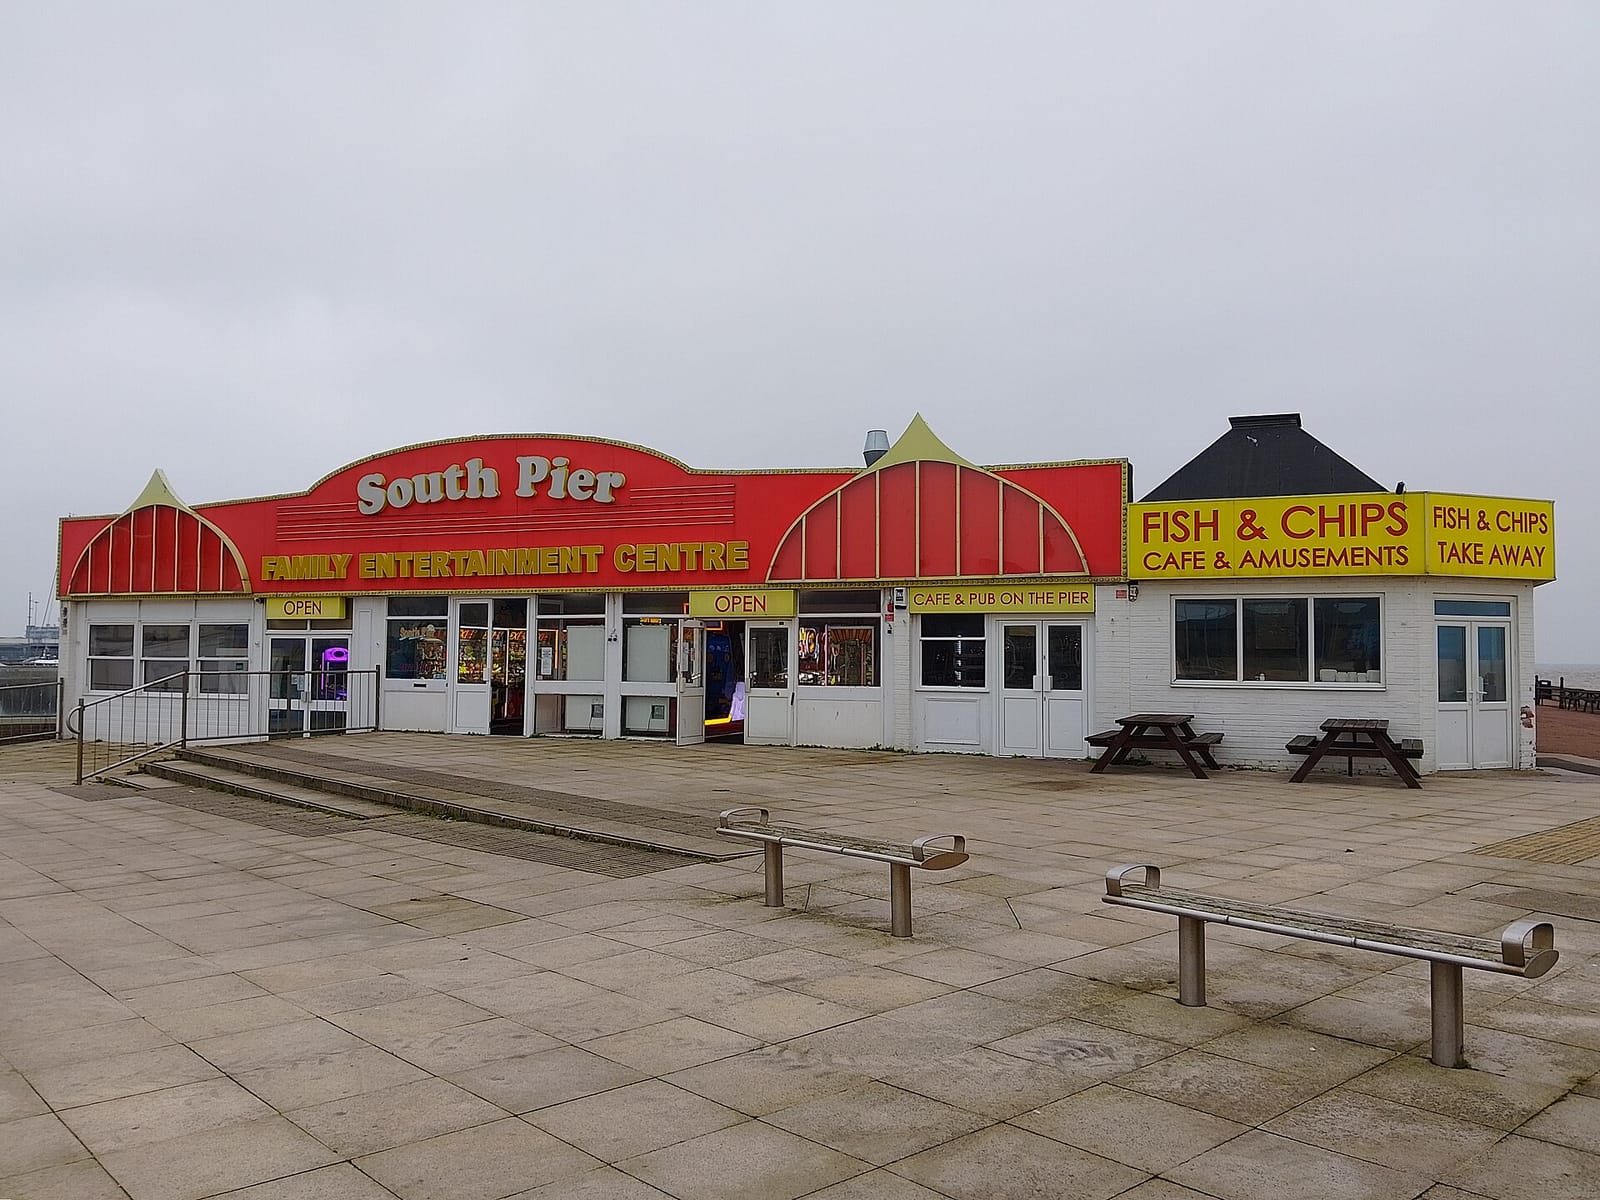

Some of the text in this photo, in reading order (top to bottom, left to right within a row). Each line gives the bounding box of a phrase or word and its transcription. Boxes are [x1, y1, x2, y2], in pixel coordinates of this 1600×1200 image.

[356, 455, 627, 515] South Pier
[1142, 501, 1410, 544] FISH & CHIPS
[1433, 506, 1549, 535] FISH & CHIPS
[261, 541, 750, 581] FAMILY ENTERTAINMENT CENTRE
[1143, 544, 1410, 571] CAFE & AMUSEMENTS
[1437, 541, 1546, 567] TAKE AWAY
[283, 600, 323, 616] OPEN
[714, 595, 767, 613] OPEN
[913, 593, 950, 606] CAFE
[954, 593, 965, 606] &
[969, 592, 996, 605] PUB
[1000, 591, 1025, 605] ON
[1028, 591, 1055, 605] THE
[1058, 591, 1090, 605] PIER
